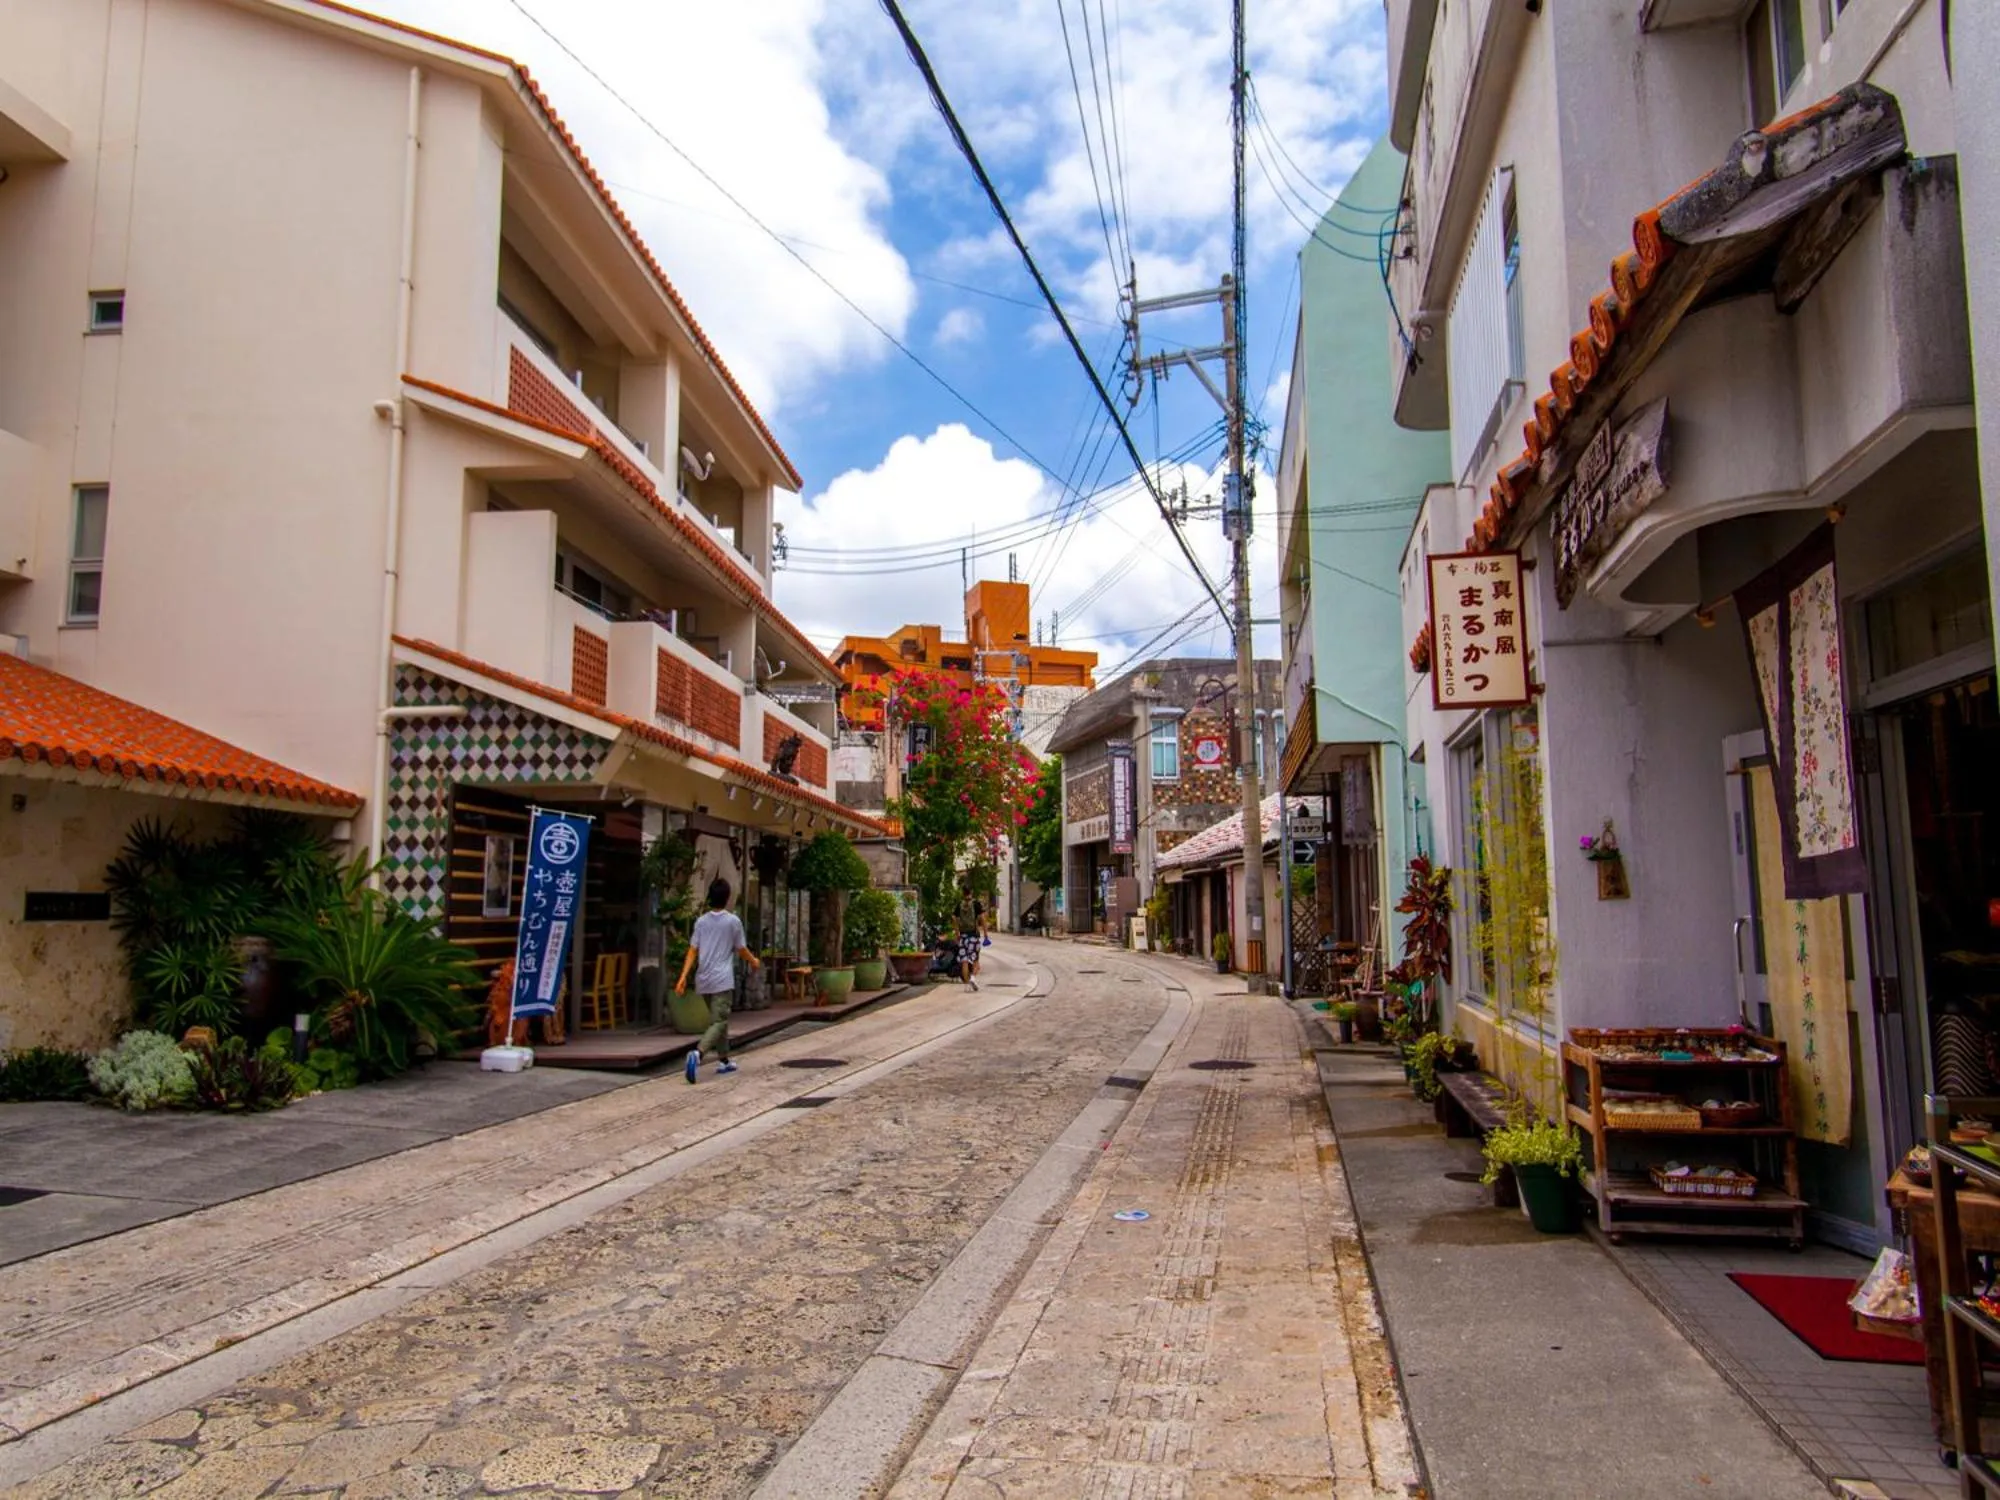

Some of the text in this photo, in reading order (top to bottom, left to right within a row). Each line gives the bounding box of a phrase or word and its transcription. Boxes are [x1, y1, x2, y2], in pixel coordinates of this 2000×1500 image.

[1458, 586, 1489, 692] まるかつ
[1491, 580, 1516, 655] 真南風
[519, 867, 553, 998] やちむん通り
[552, 869, 578, 917] 壺屋
